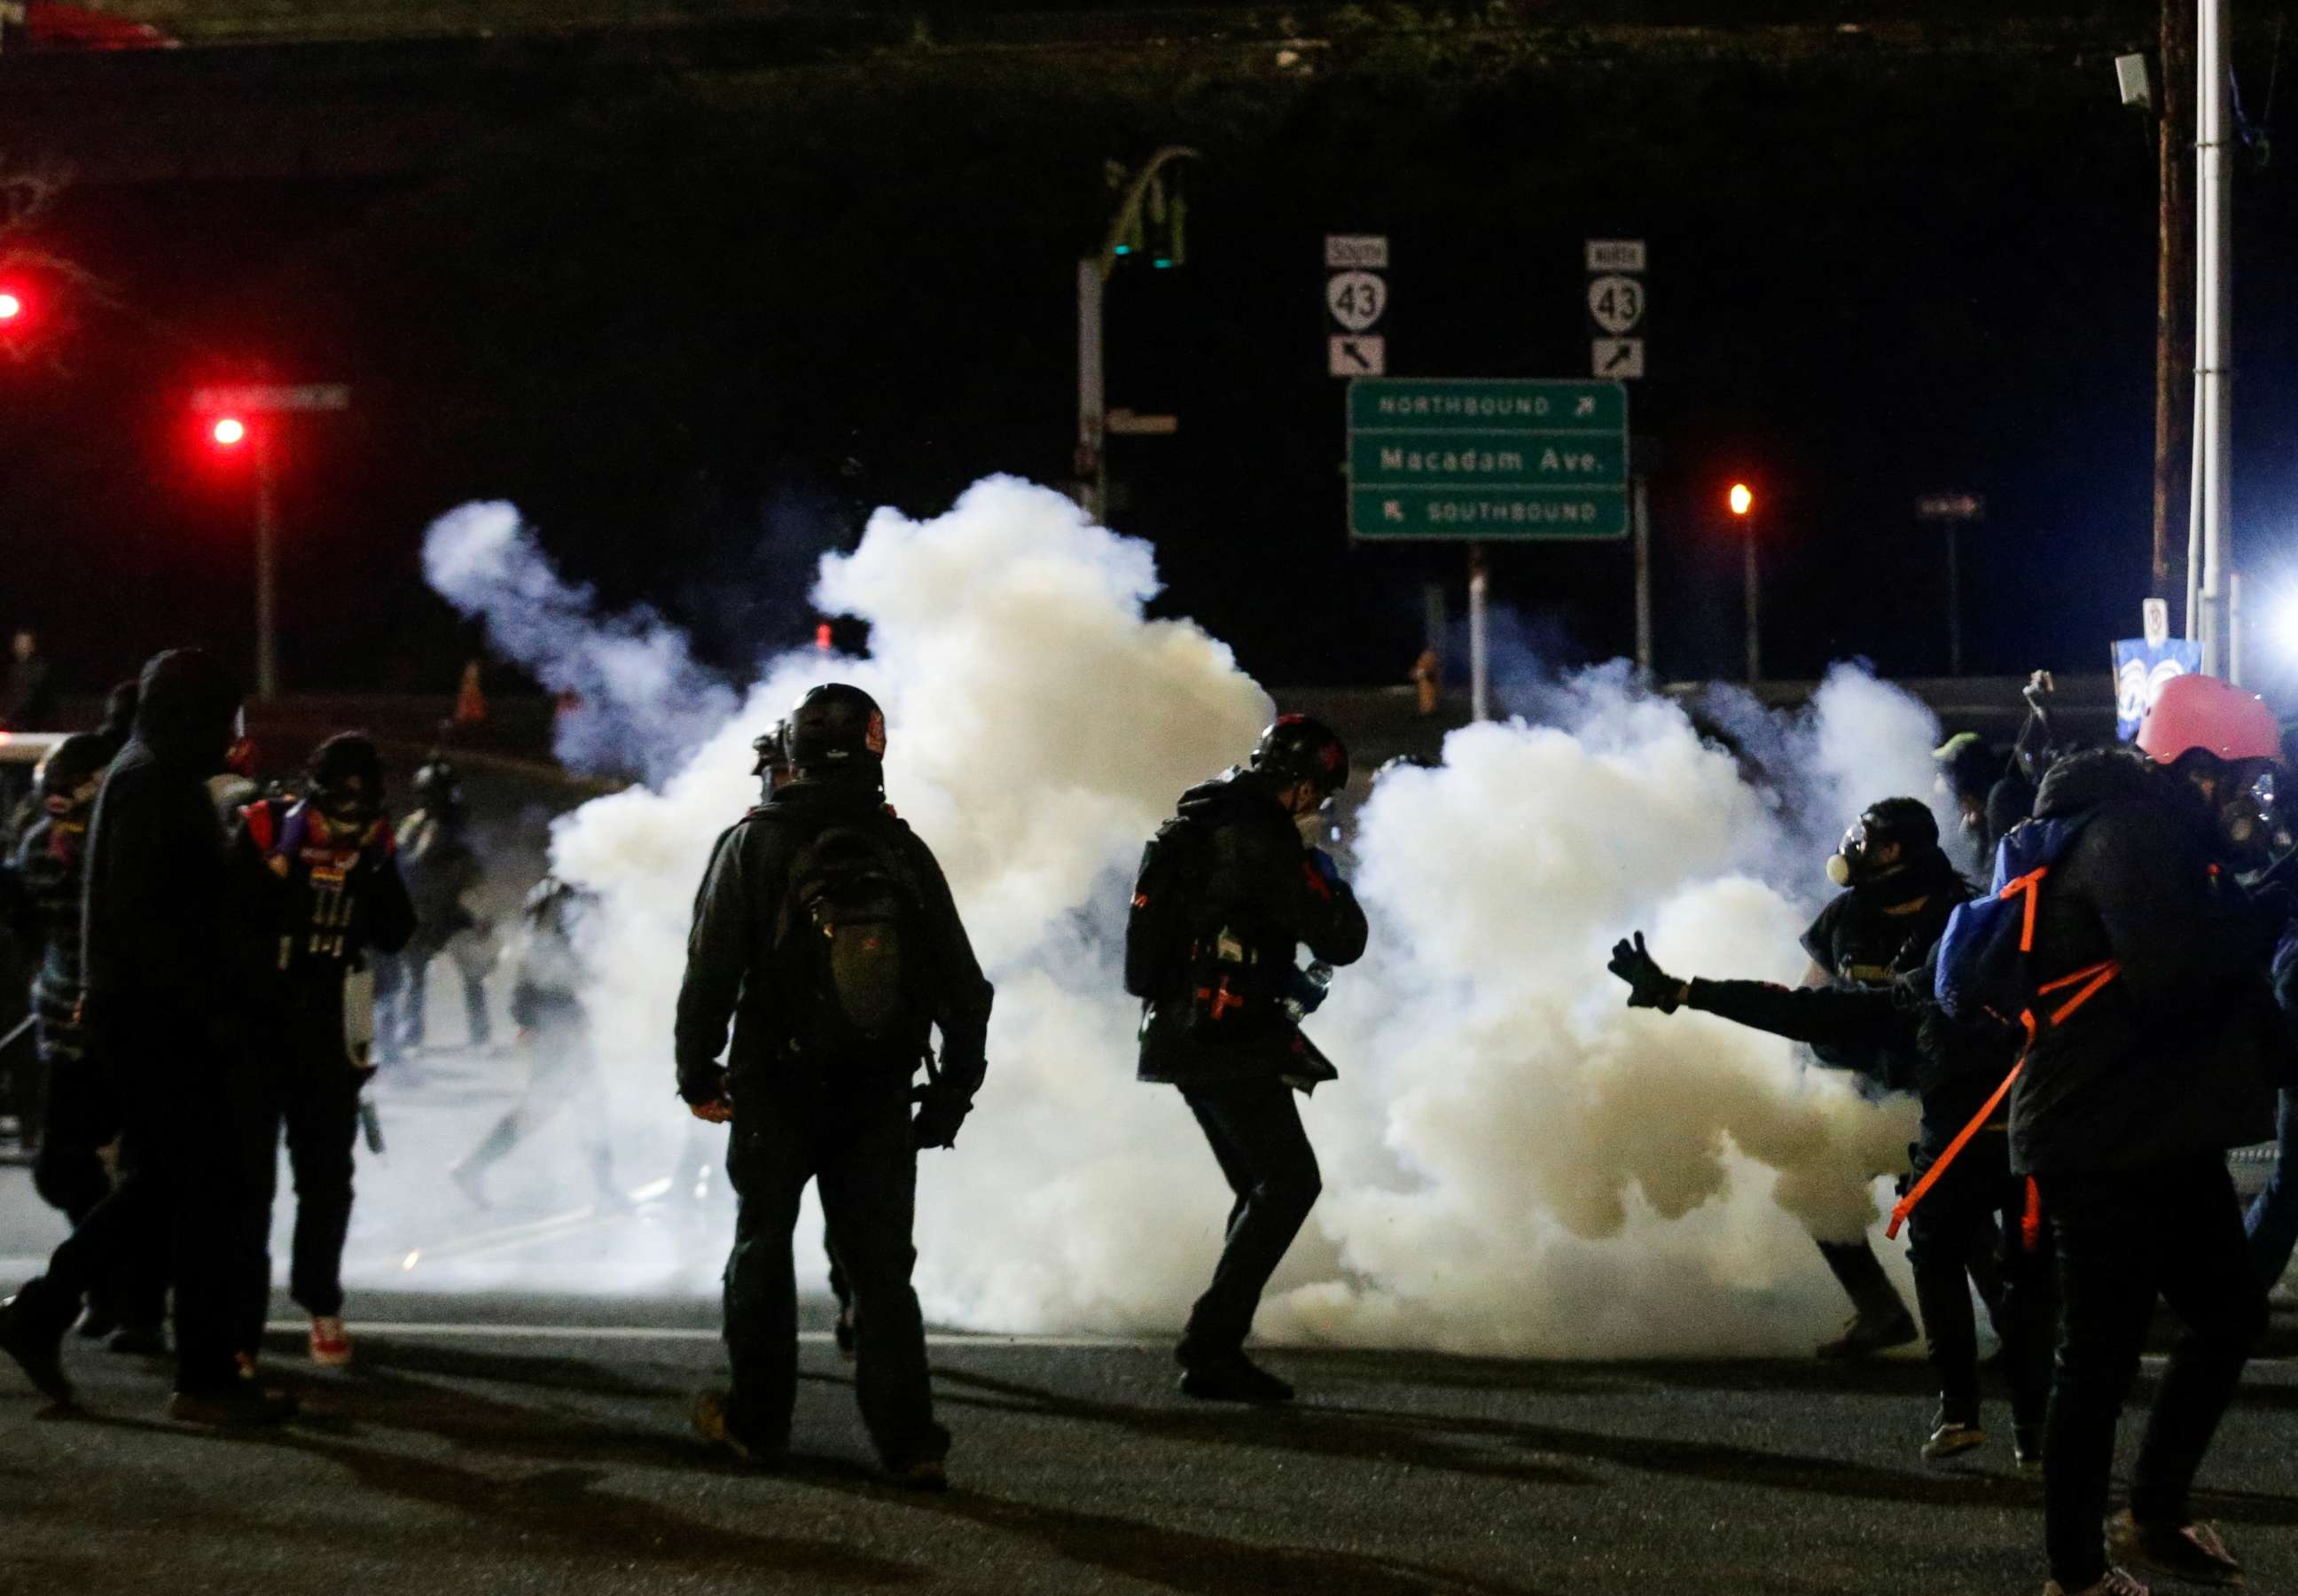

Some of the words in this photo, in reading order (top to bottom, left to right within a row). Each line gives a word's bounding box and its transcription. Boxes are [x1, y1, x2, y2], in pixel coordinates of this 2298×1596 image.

[1337, 284, 1377, 318] 43
[1597, 286, 1638, 321] 43
[1380, 395, 1549, 415] NORTHBOUND
[1380, 447, 1523, 472] Macadam
[1541, 447, 1604, 472] Ave.
[1427, 502, 1596, 522] SOUTHBOUND
